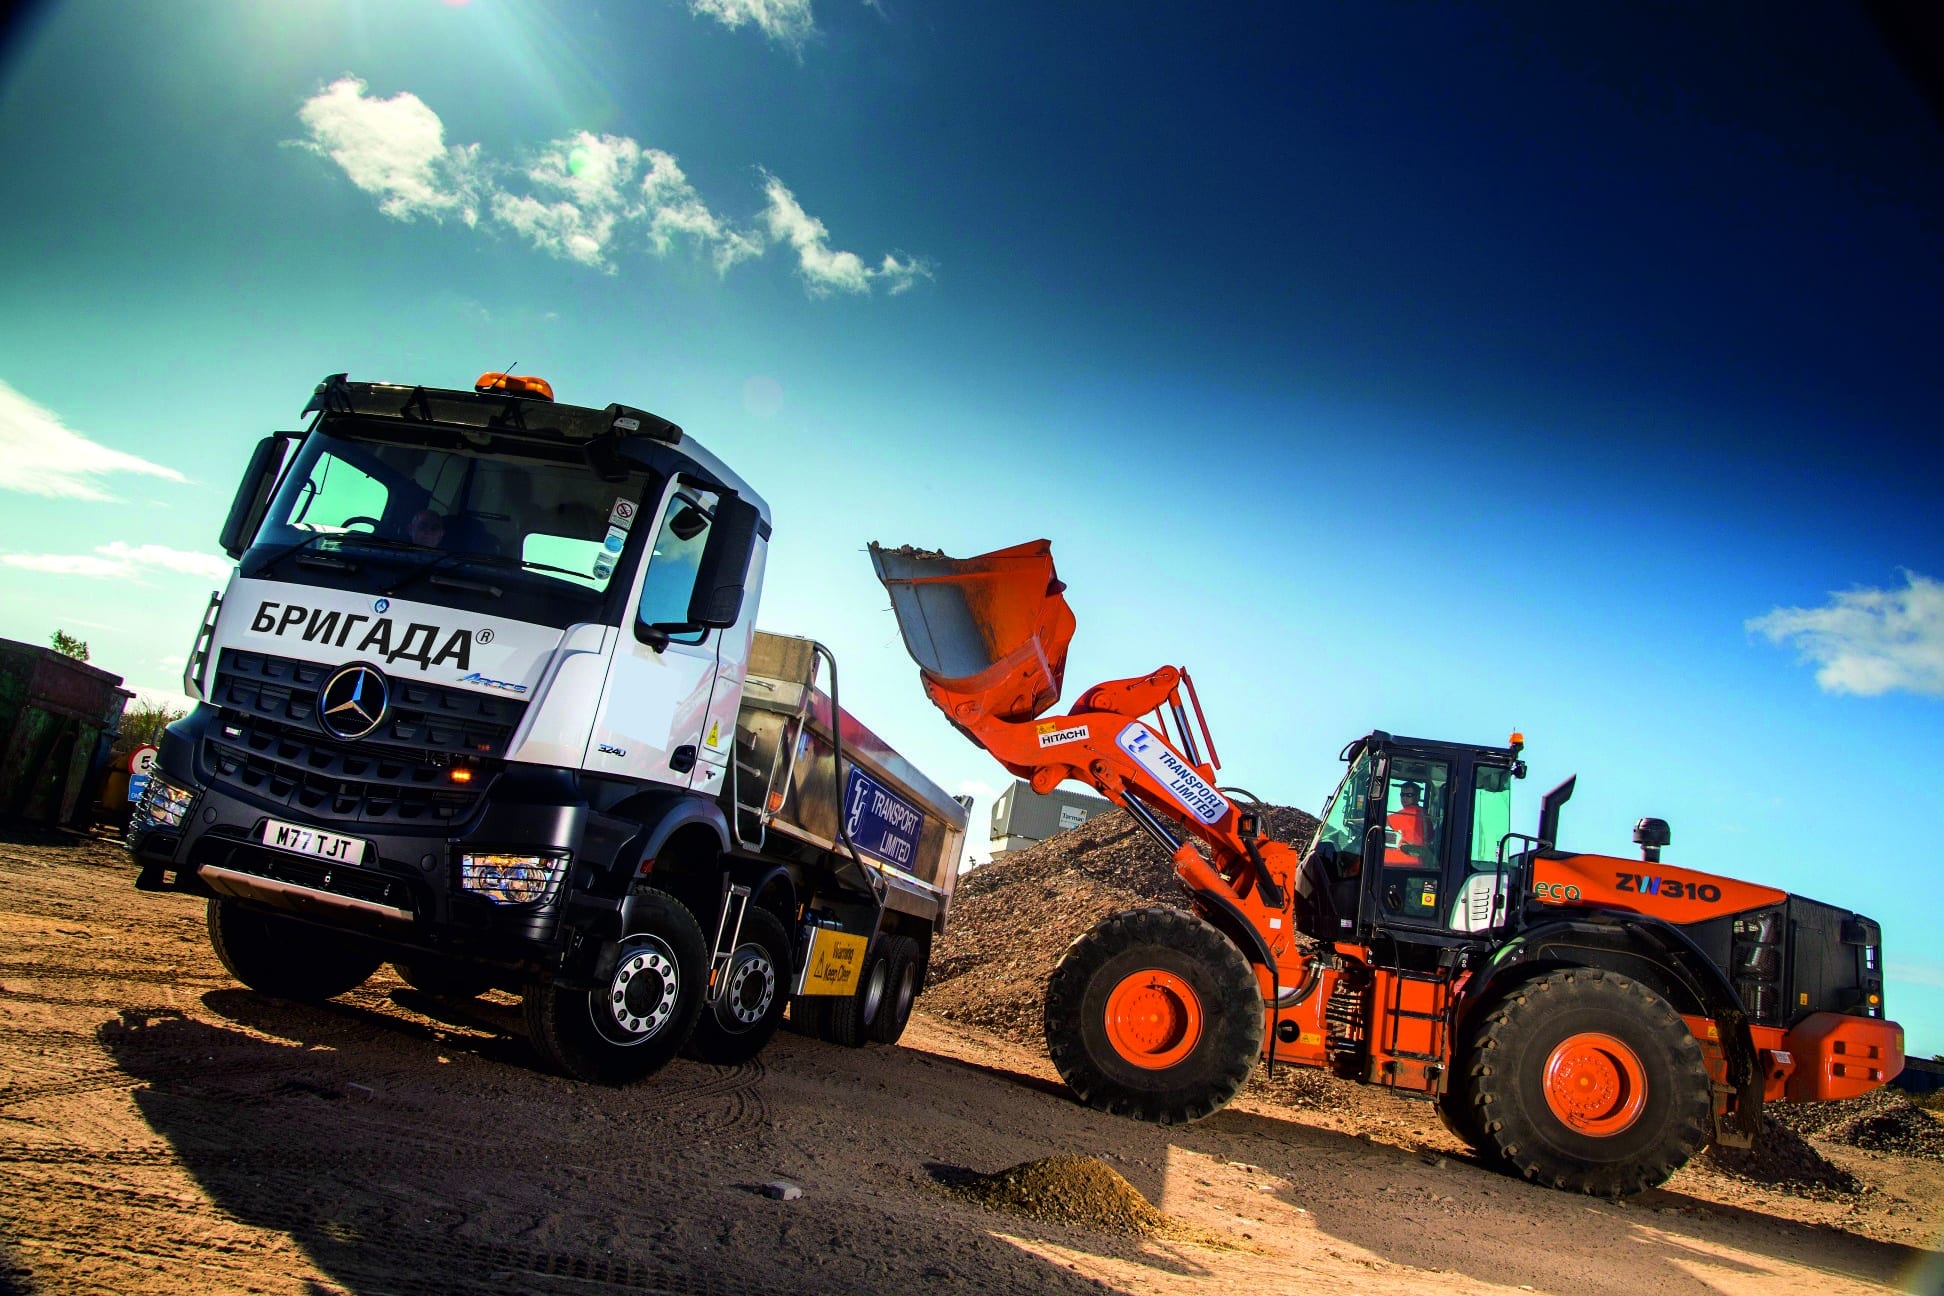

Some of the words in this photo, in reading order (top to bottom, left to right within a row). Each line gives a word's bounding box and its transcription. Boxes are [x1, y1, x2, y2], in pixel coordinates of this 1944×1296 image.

[598, 743, 627, 757] 3240
[1042, 728, 1086, 745] HITACHI
[140, 755, 152, 770] 5
[1159, 751, 1224, 809] TRANSPORT
[871, 789, 918, 836] TRANSPORT
[1169, 779, 1216, 819] LIMITED
[276, 826, 312, 850] M77
[317, 834, 352, 859] TJT
[880, 830, 911, 864] LIMITED
[1534, 882, 1582, 902] eco
[1615, 872, 1722, 903] ZW310
[833, 941, 855, 965] Warning
